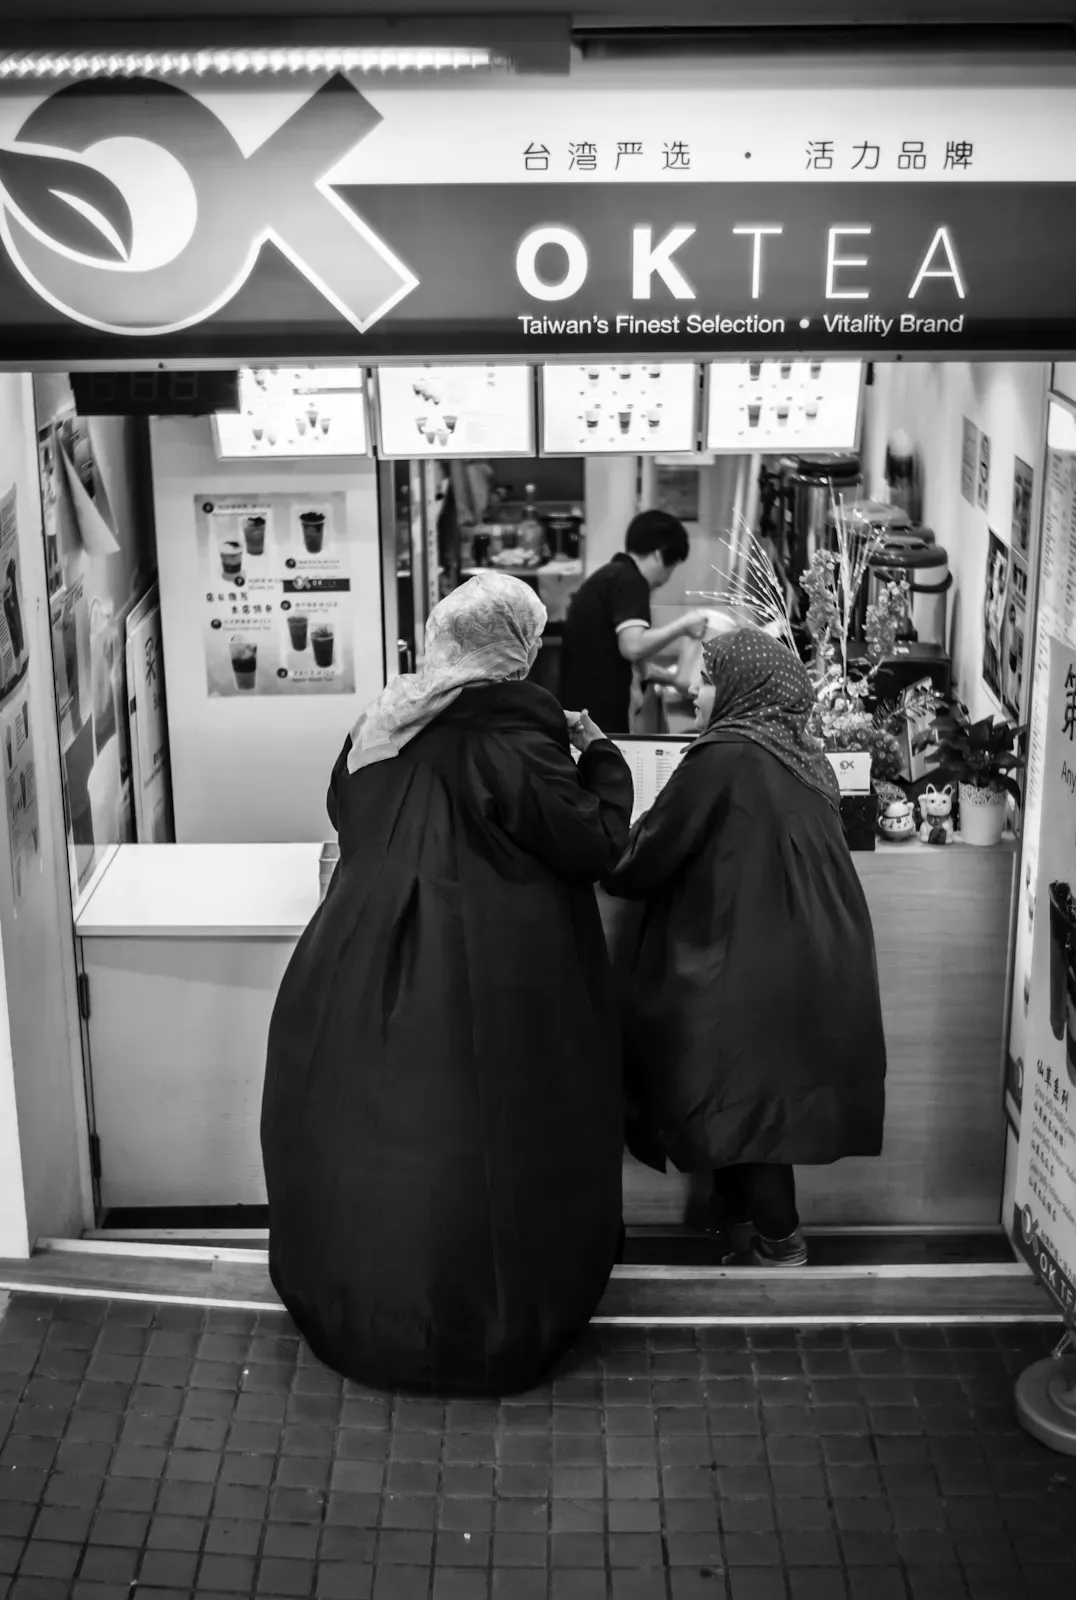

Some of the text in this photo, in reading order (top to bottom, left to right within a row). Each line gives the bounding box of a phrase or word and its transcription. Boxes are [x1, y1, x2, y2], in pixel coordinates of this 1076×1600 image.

[522, 139, 975, 171] 台湾严选 活力品牌
[615, 314, 681, 334] Finest
[686, 313, 785, 334] Selection
[822, 313, 894, 337] Vitality
[900, 313, 964, 333] Brand
